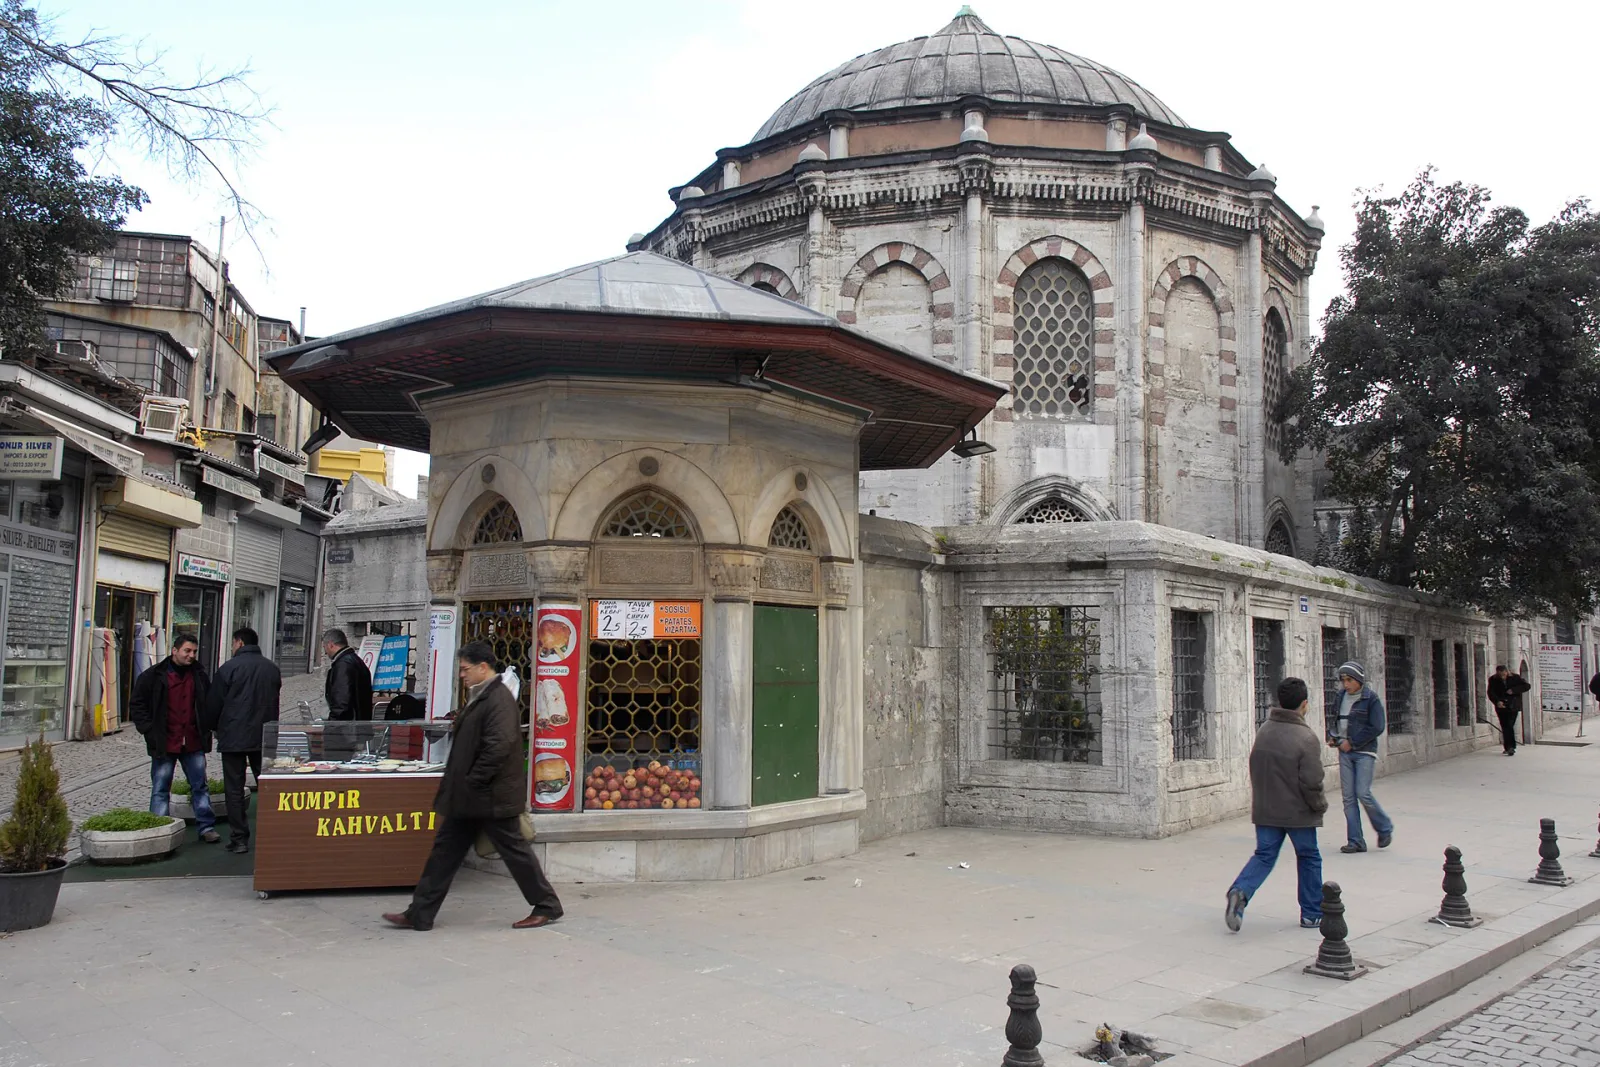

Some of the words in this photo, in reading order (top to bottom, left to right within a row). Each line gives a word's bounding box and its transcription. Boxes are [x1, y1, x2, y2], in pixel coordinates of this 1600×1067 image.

[0, 441, 23, 450] ONUR
[26, 441, 53, 450] SILVER
[3, 529, 23, 547] SILVER
[27, 534, 57, 554] JEWELLERY
[664, 617, 692, 626] PATATES
[664, 625, 698, 634] KIZARTMA
[316, 811, 436, 837] KAHVALTI
